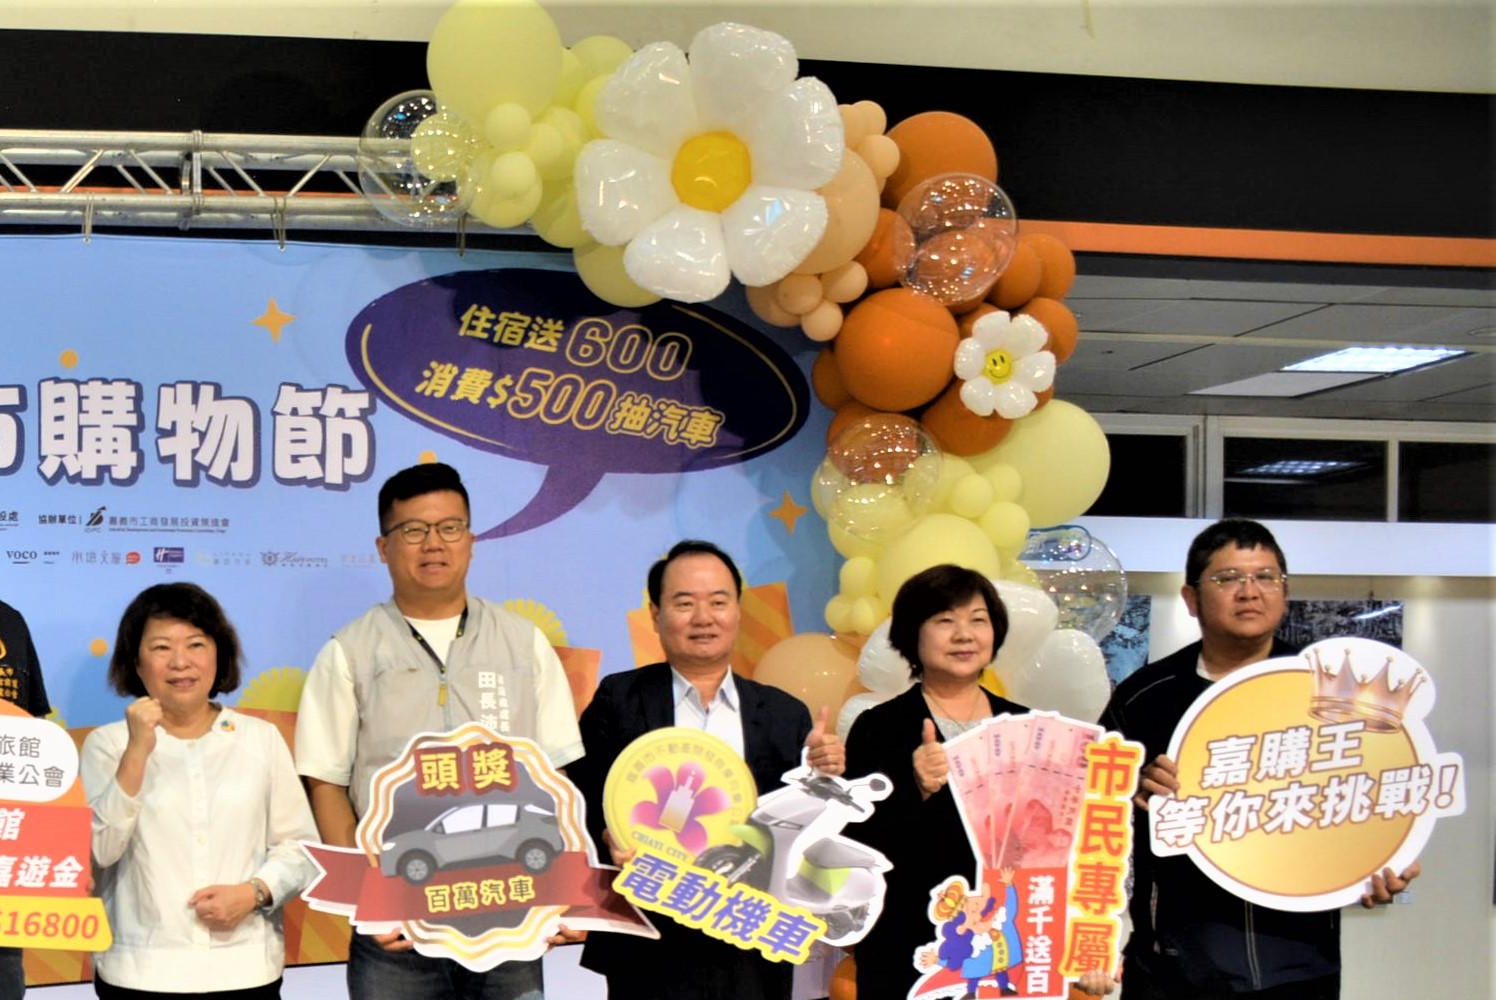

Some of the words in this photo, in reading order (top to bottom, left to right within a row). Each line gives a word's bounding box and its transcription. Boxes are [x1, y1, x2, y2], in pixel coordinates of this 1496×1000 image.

[457, 304, 692, 381] 住宿送600
[414, 360, 725, 449] 消費$500抽汽車
[420, 746, 513, 791] 頭獎
[1199, 720, 1366, 790] 嘉購王
[425, 876, 536, 914] 百萬汽車
[1065, 741, 1141, 973] 市民專屬
[620, 853, 820, 957] 電動機車
[1025, 874, 1055, 994] 滿千送百
